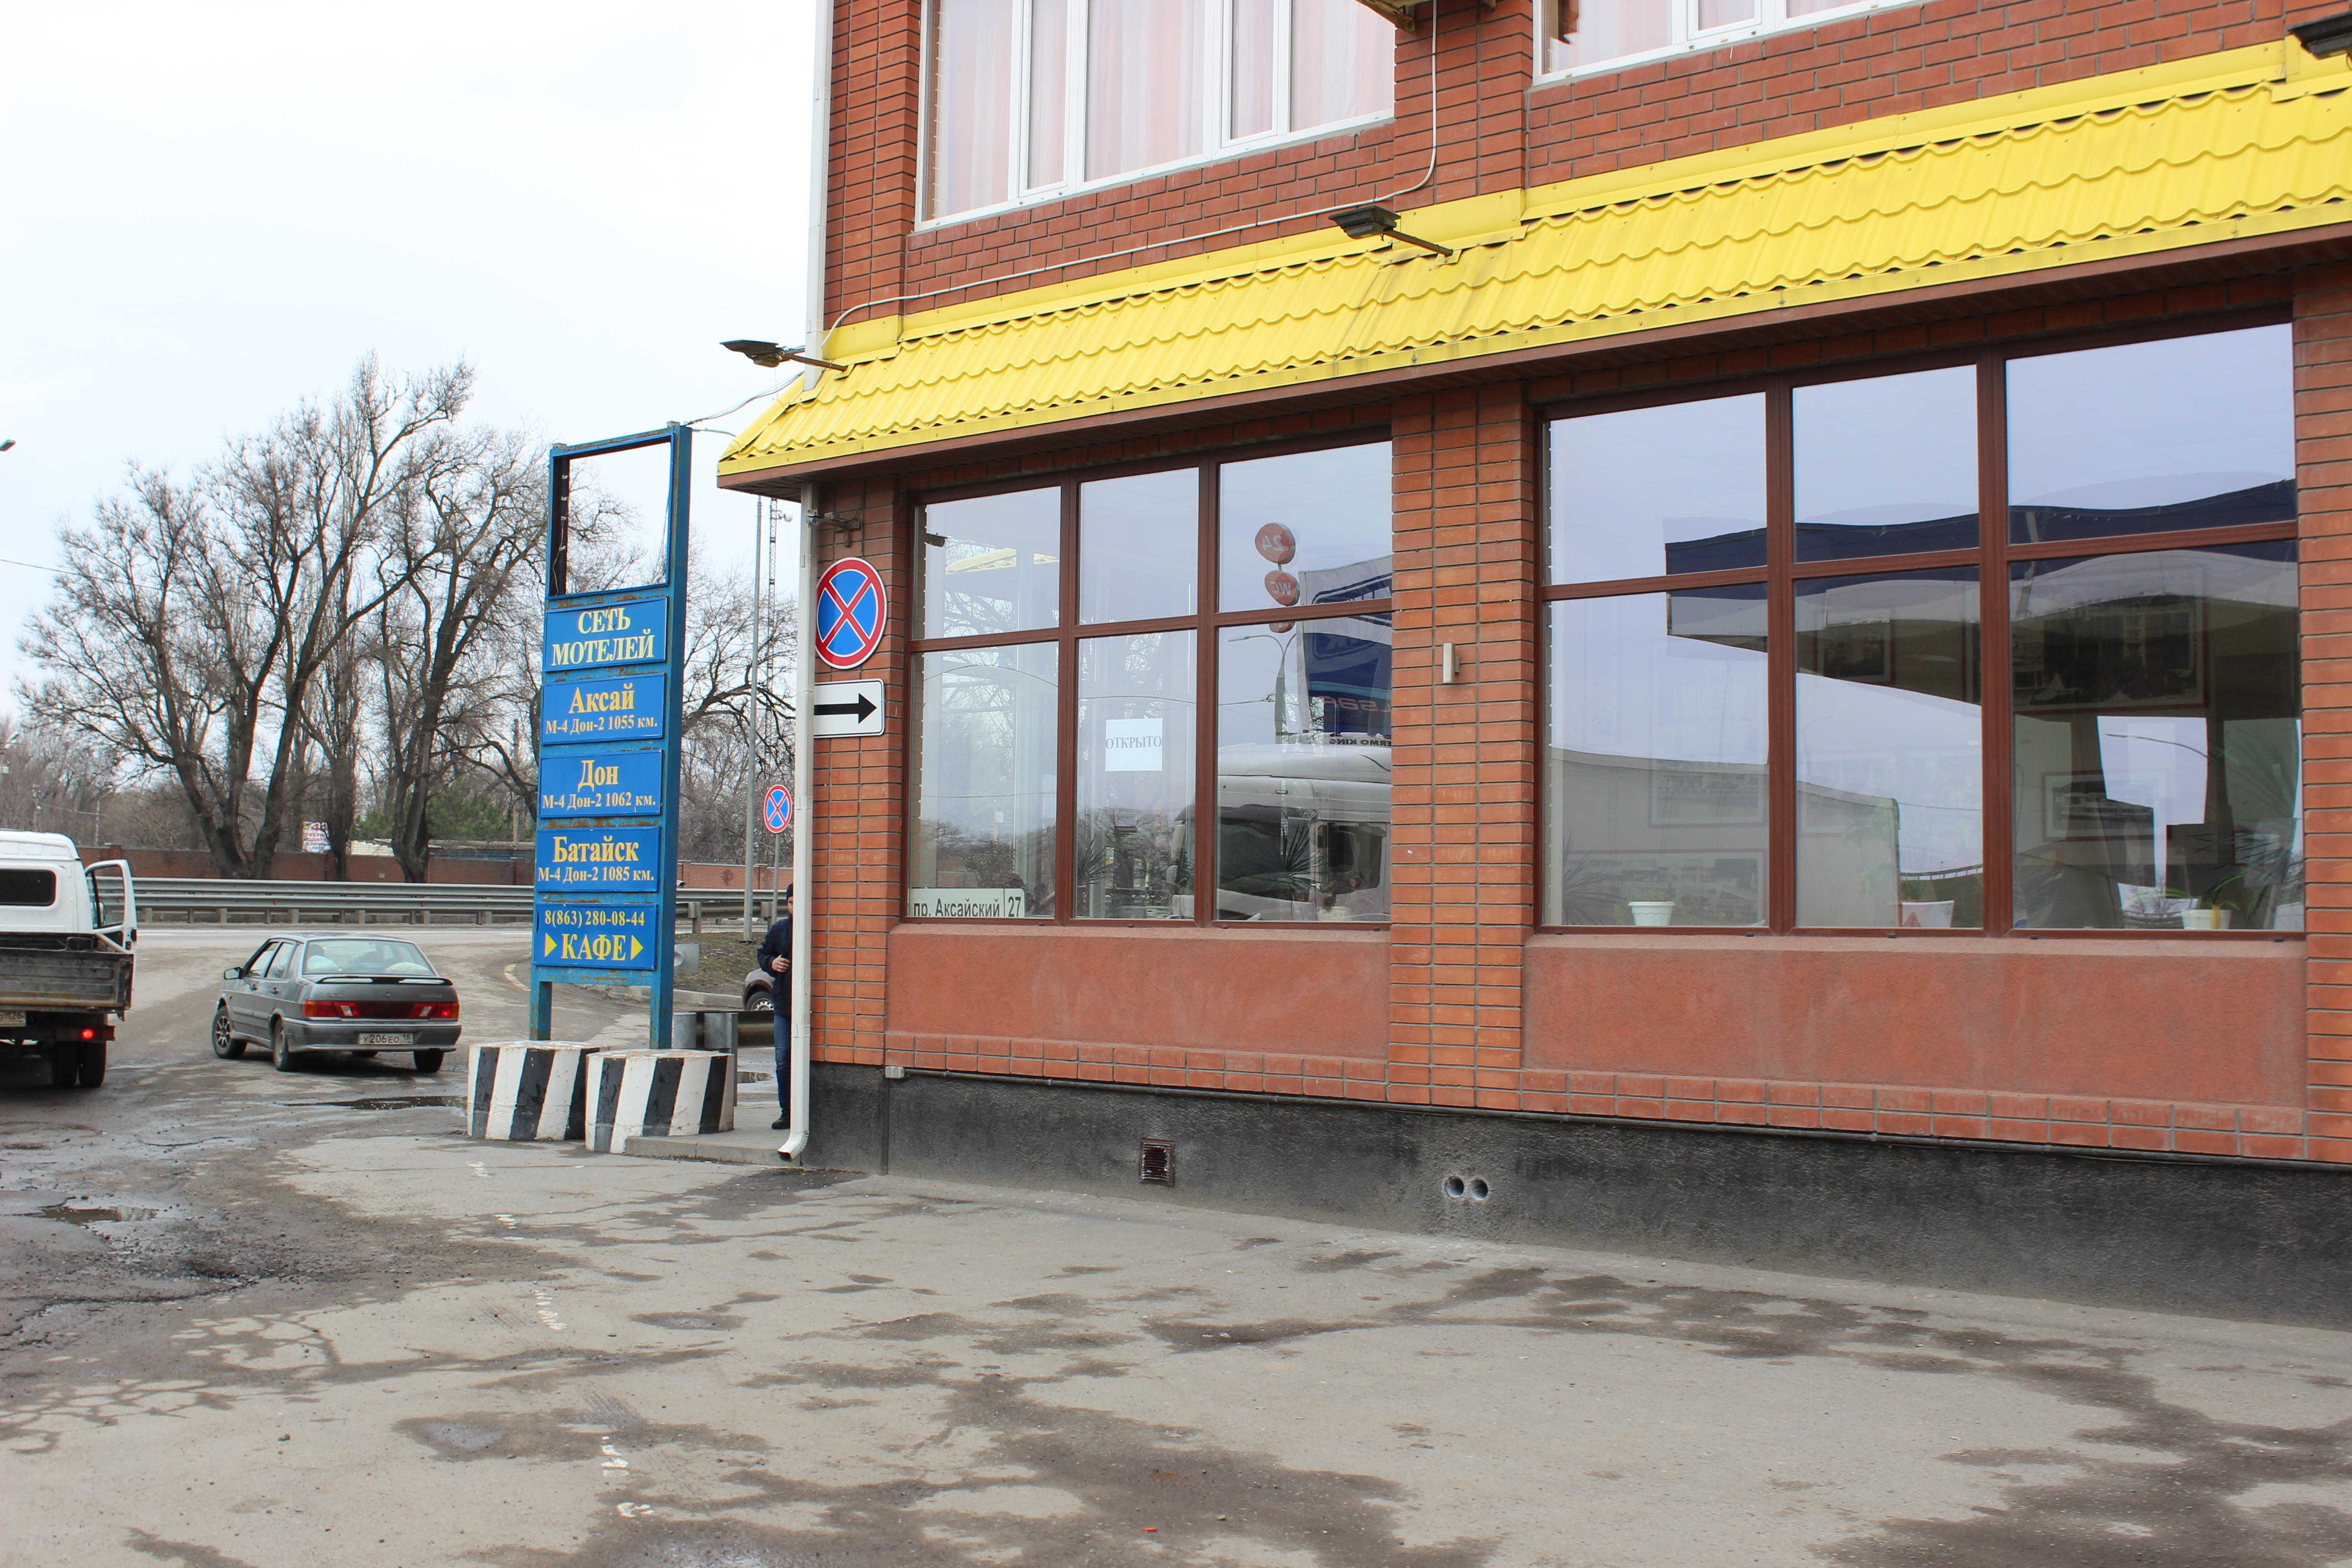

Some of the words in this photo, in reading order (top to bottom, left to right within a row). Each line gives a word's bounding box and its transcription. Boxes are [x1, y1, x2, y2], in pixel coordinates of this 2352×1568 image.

[578, 608, 631, 634] СЕТЬ
[551, 628, 655, 666] МОТЕЛЕЙ
[568, 683, 635, 714] Аксай
[546, 720, 568, 735] М-4
[570, 716, 605, 735] Дон-2
[608, 715, 635, 730] 1055
[637, 716, 658, 728] км.
[1106, 736, 1162, 749] ОТКРЫТО
[578, 760, 619, 792] Дон
[542, 794, 565, 808] М-4
[567, 793, 602, 811] Дон-2
[605, 792, 632, 807] 1062
[635, 794, 656, 806] км.
[553, 835, 639, 862] Батайск
[538, 867, 561, 881] М-4
[563, 867, 598, 884] Дон-2
[602, 866, 630, 881] 1085
[632, 869, 654, 881] км.
[914, 903, 931, 916] пр.
[935, 898, 1000, 917] Аксайский
[1008, 897, 1021, 917] 27
[545, 910, 583, 928] 8(863)
[585, 911, 645, 926] 280-08-44
[561, 933, 626, 960] КАФЕ
